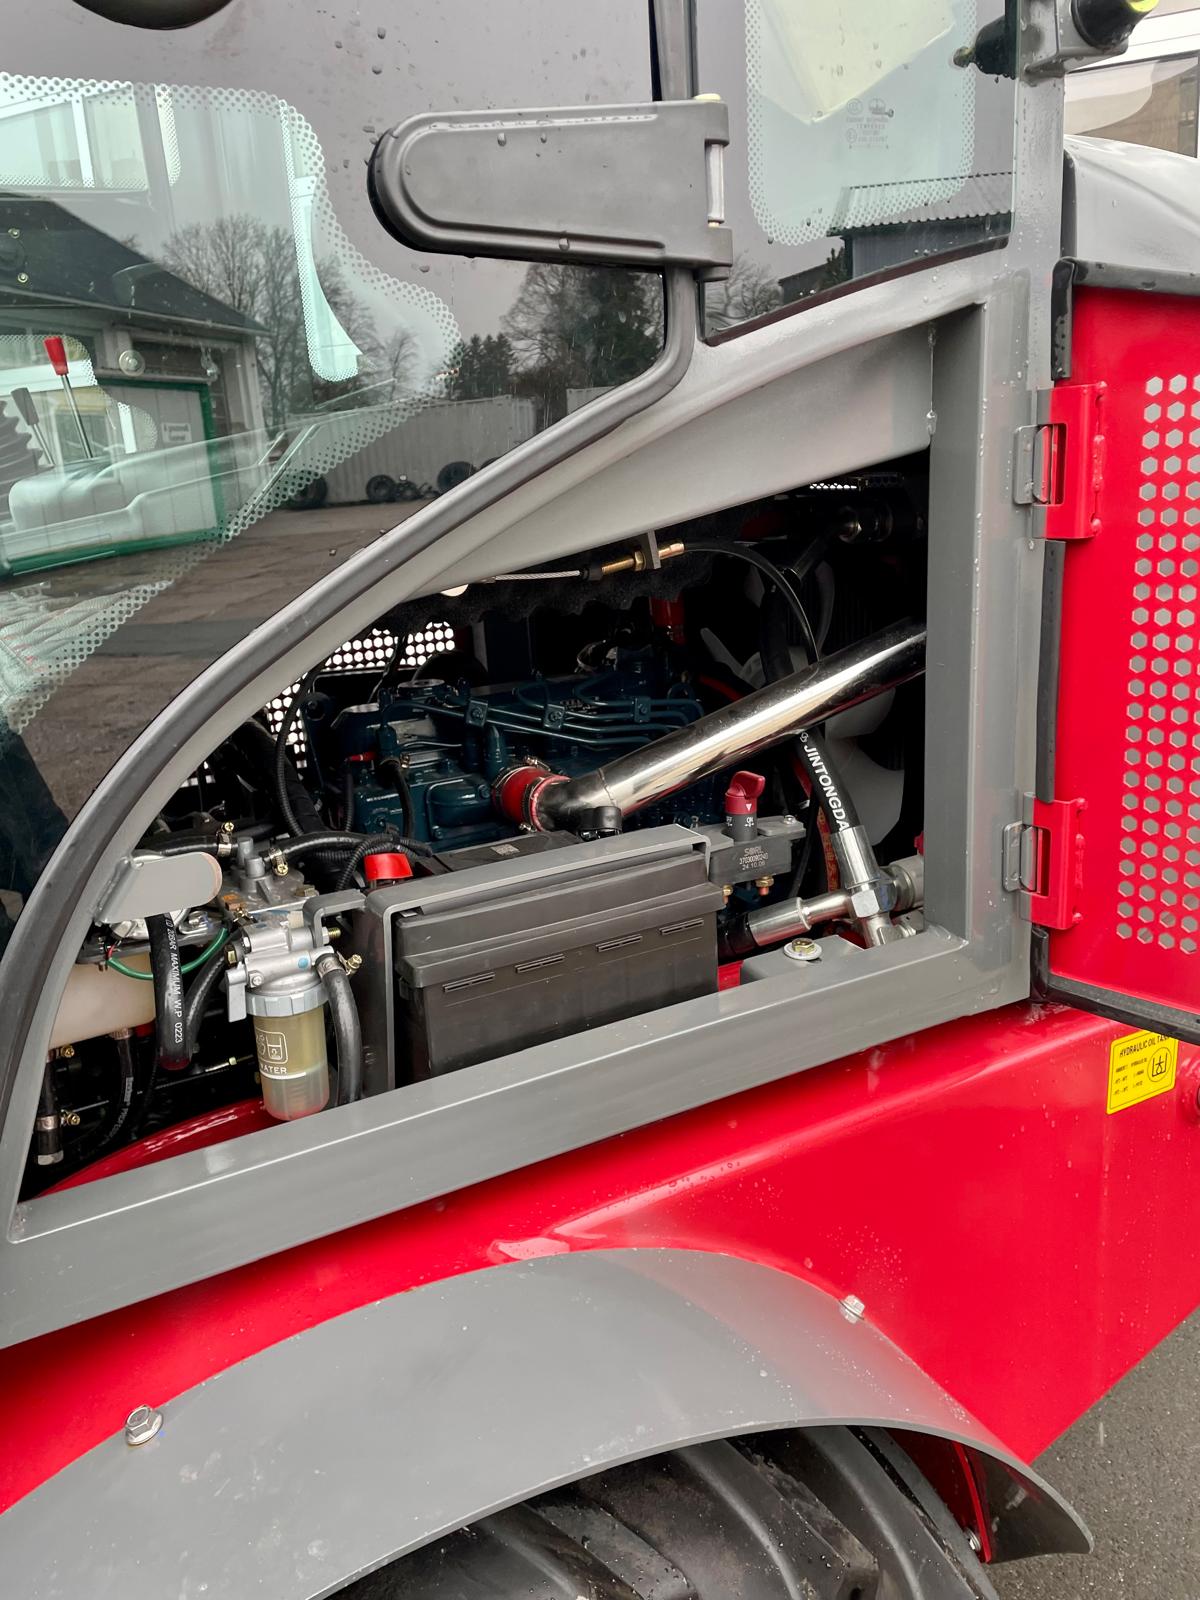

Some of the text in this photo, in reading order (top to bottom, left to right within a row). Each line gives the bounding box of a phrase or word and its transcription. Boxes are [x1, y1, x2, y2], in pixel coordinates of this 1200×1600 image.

[804, 745, 850, 832] JINTONGDA
[746, 816, 754, 824] ON
[170, 952, 181, 995] MAXIMUM
[174, 1022, 183, 1044] 0223
